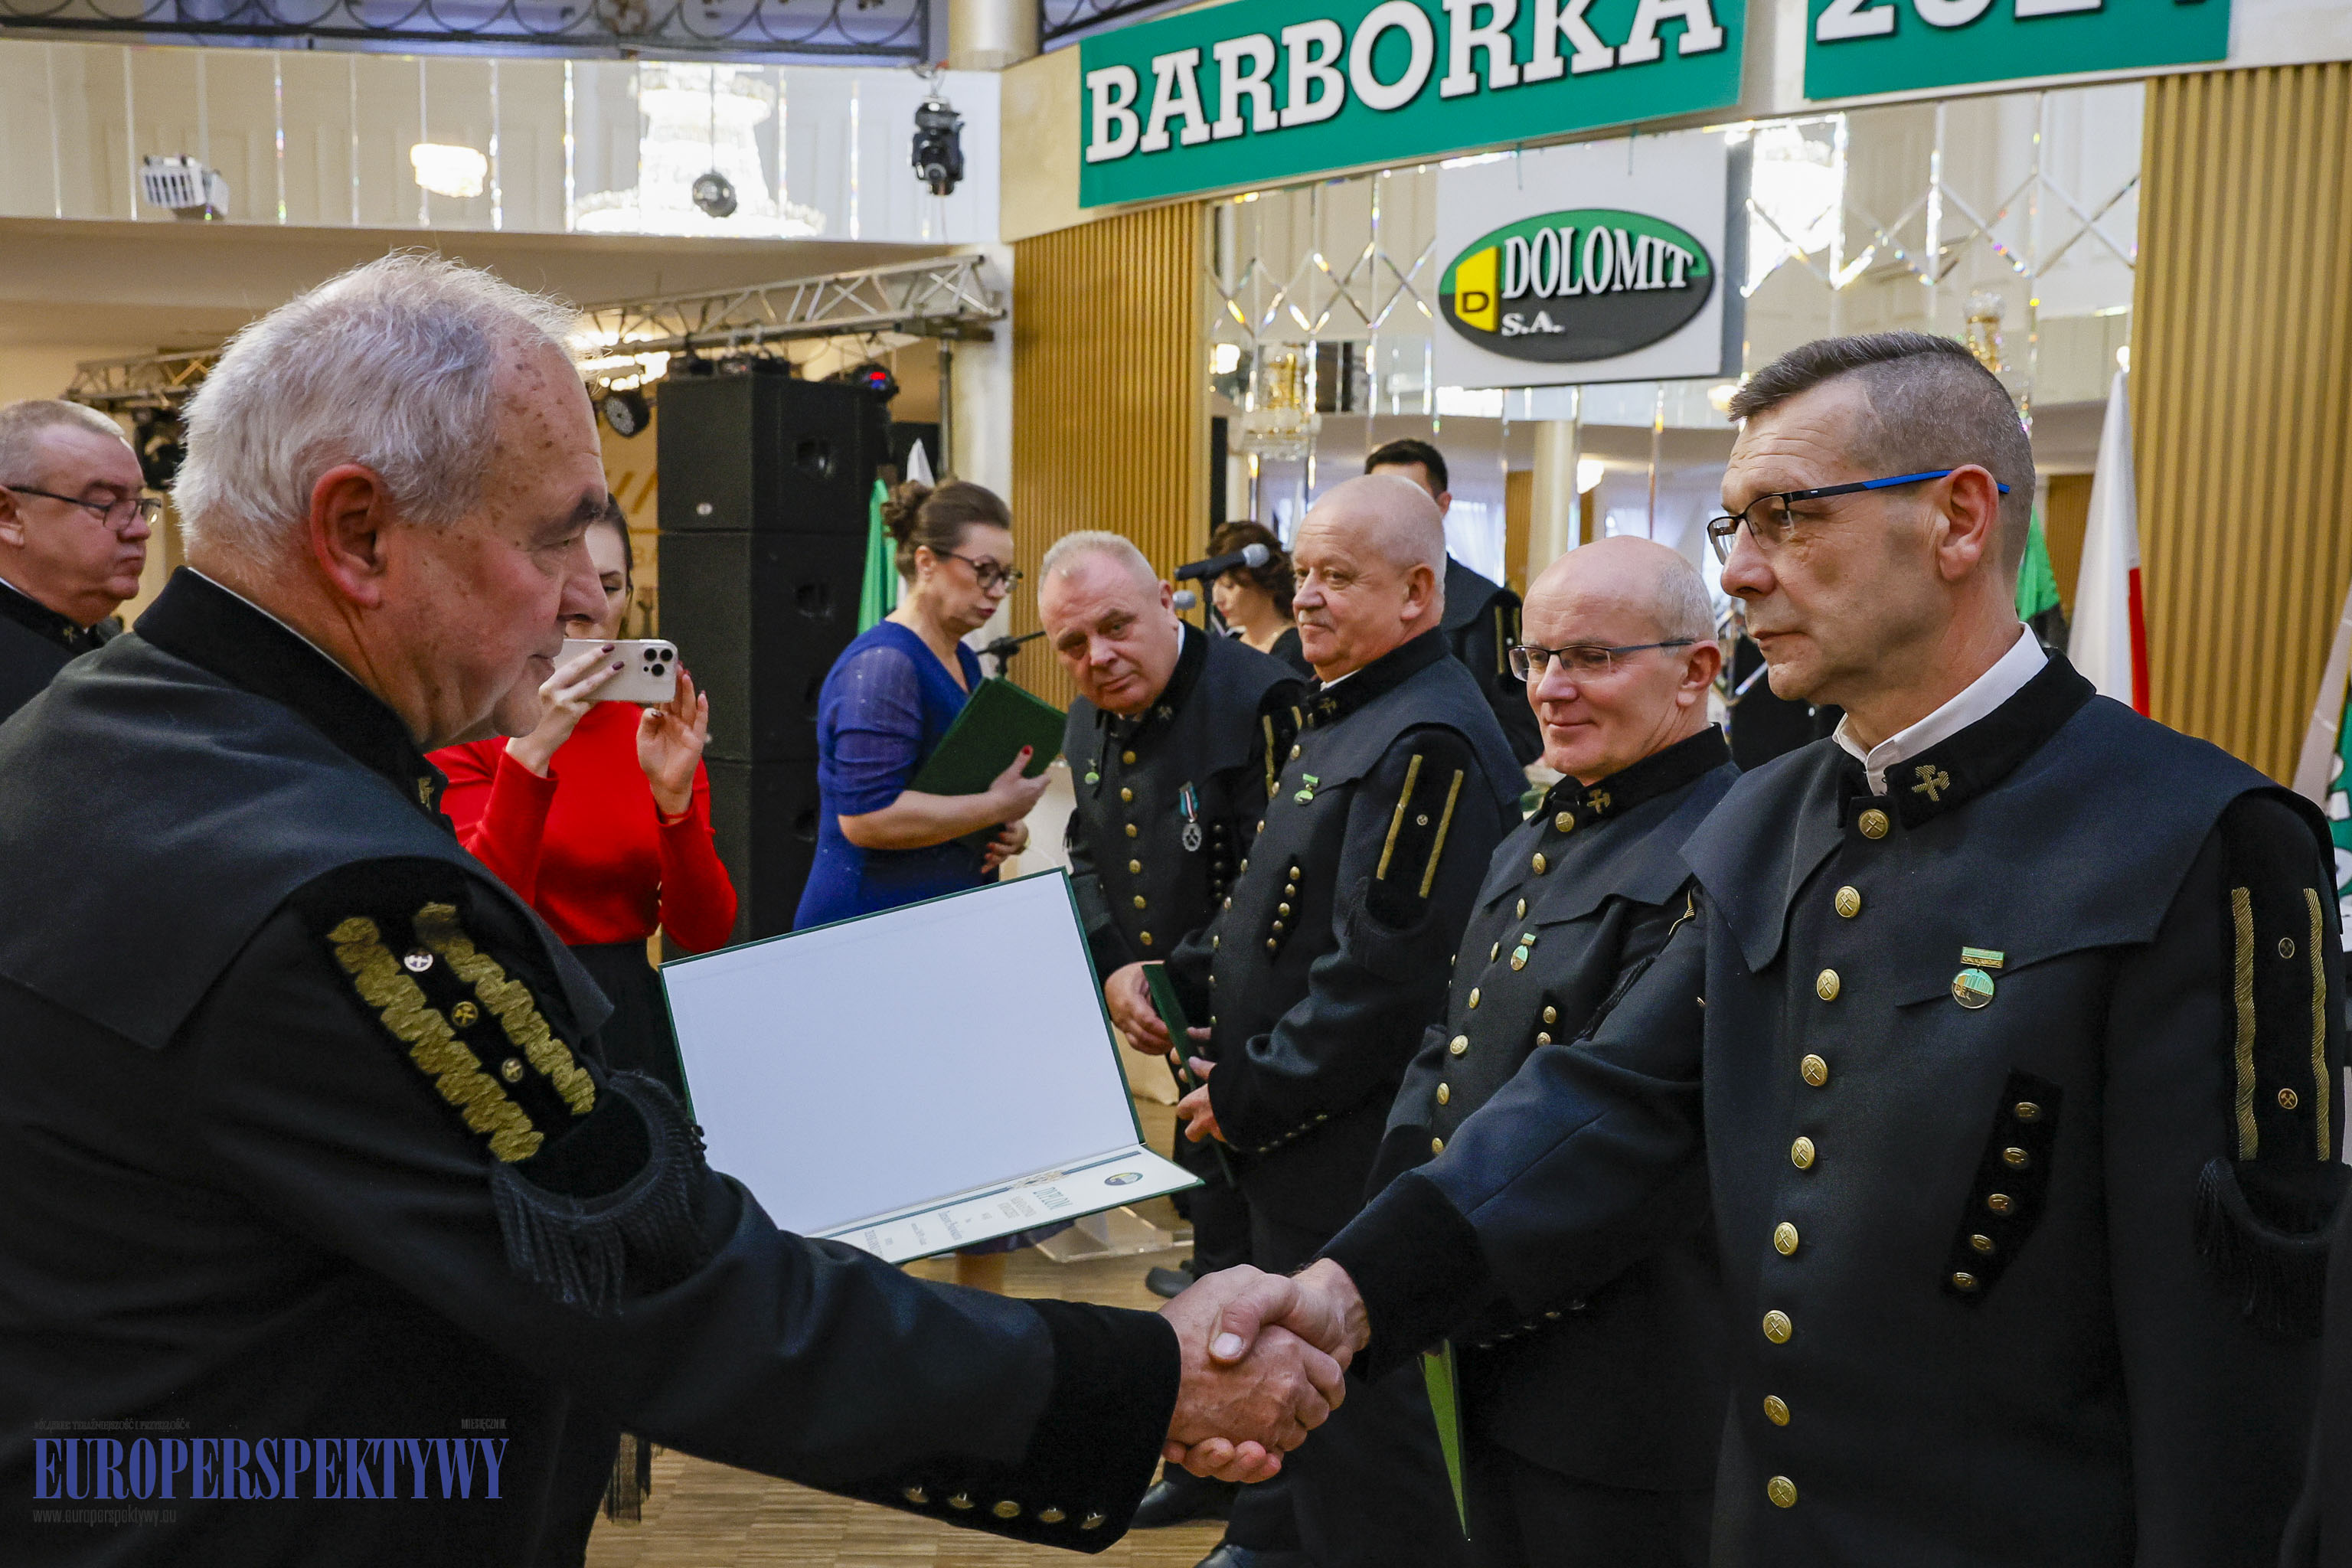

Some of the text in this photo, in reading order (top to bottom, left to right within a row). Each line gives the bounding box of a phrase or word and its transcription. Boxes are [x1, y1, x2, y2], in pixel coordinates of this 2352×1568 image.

[1501, 226, 1694, 299] DOLOMIT
[1462, 292, 1489, 312] D
[1501, 310, 1565, 336] S.A.
